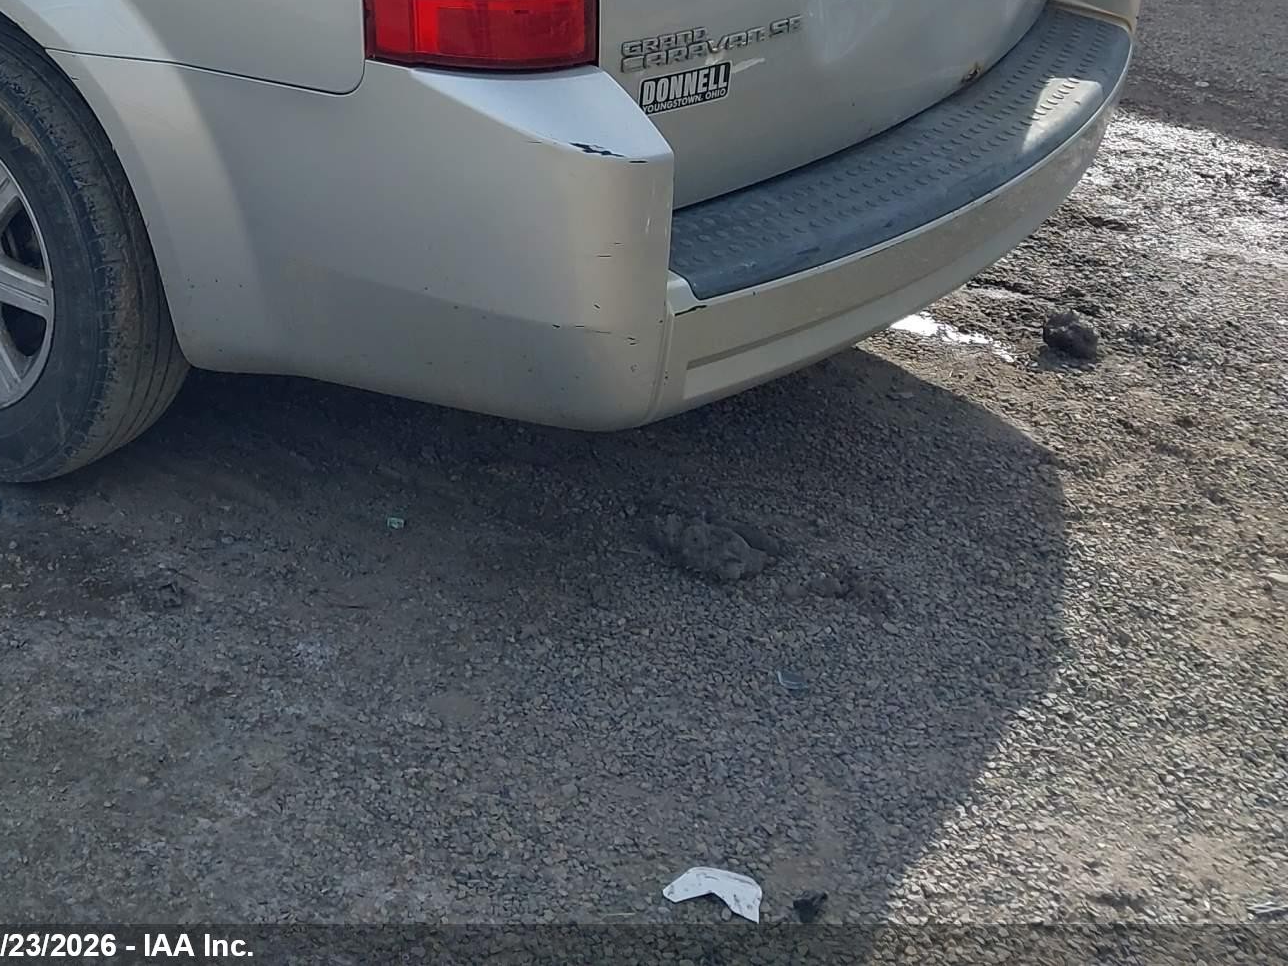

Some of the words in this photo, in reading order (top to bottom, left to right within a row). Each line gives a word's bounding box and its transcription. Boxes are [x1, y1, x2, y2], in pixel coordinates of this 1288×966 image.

[620, 27, 765, 72] CARAVAN
[769, 14, 804, 37] SE
[621, 27, 707, 57] GRAND
[642, 63, 728, 105] DONNELL
[705, 88, 726, 100] OHIO
